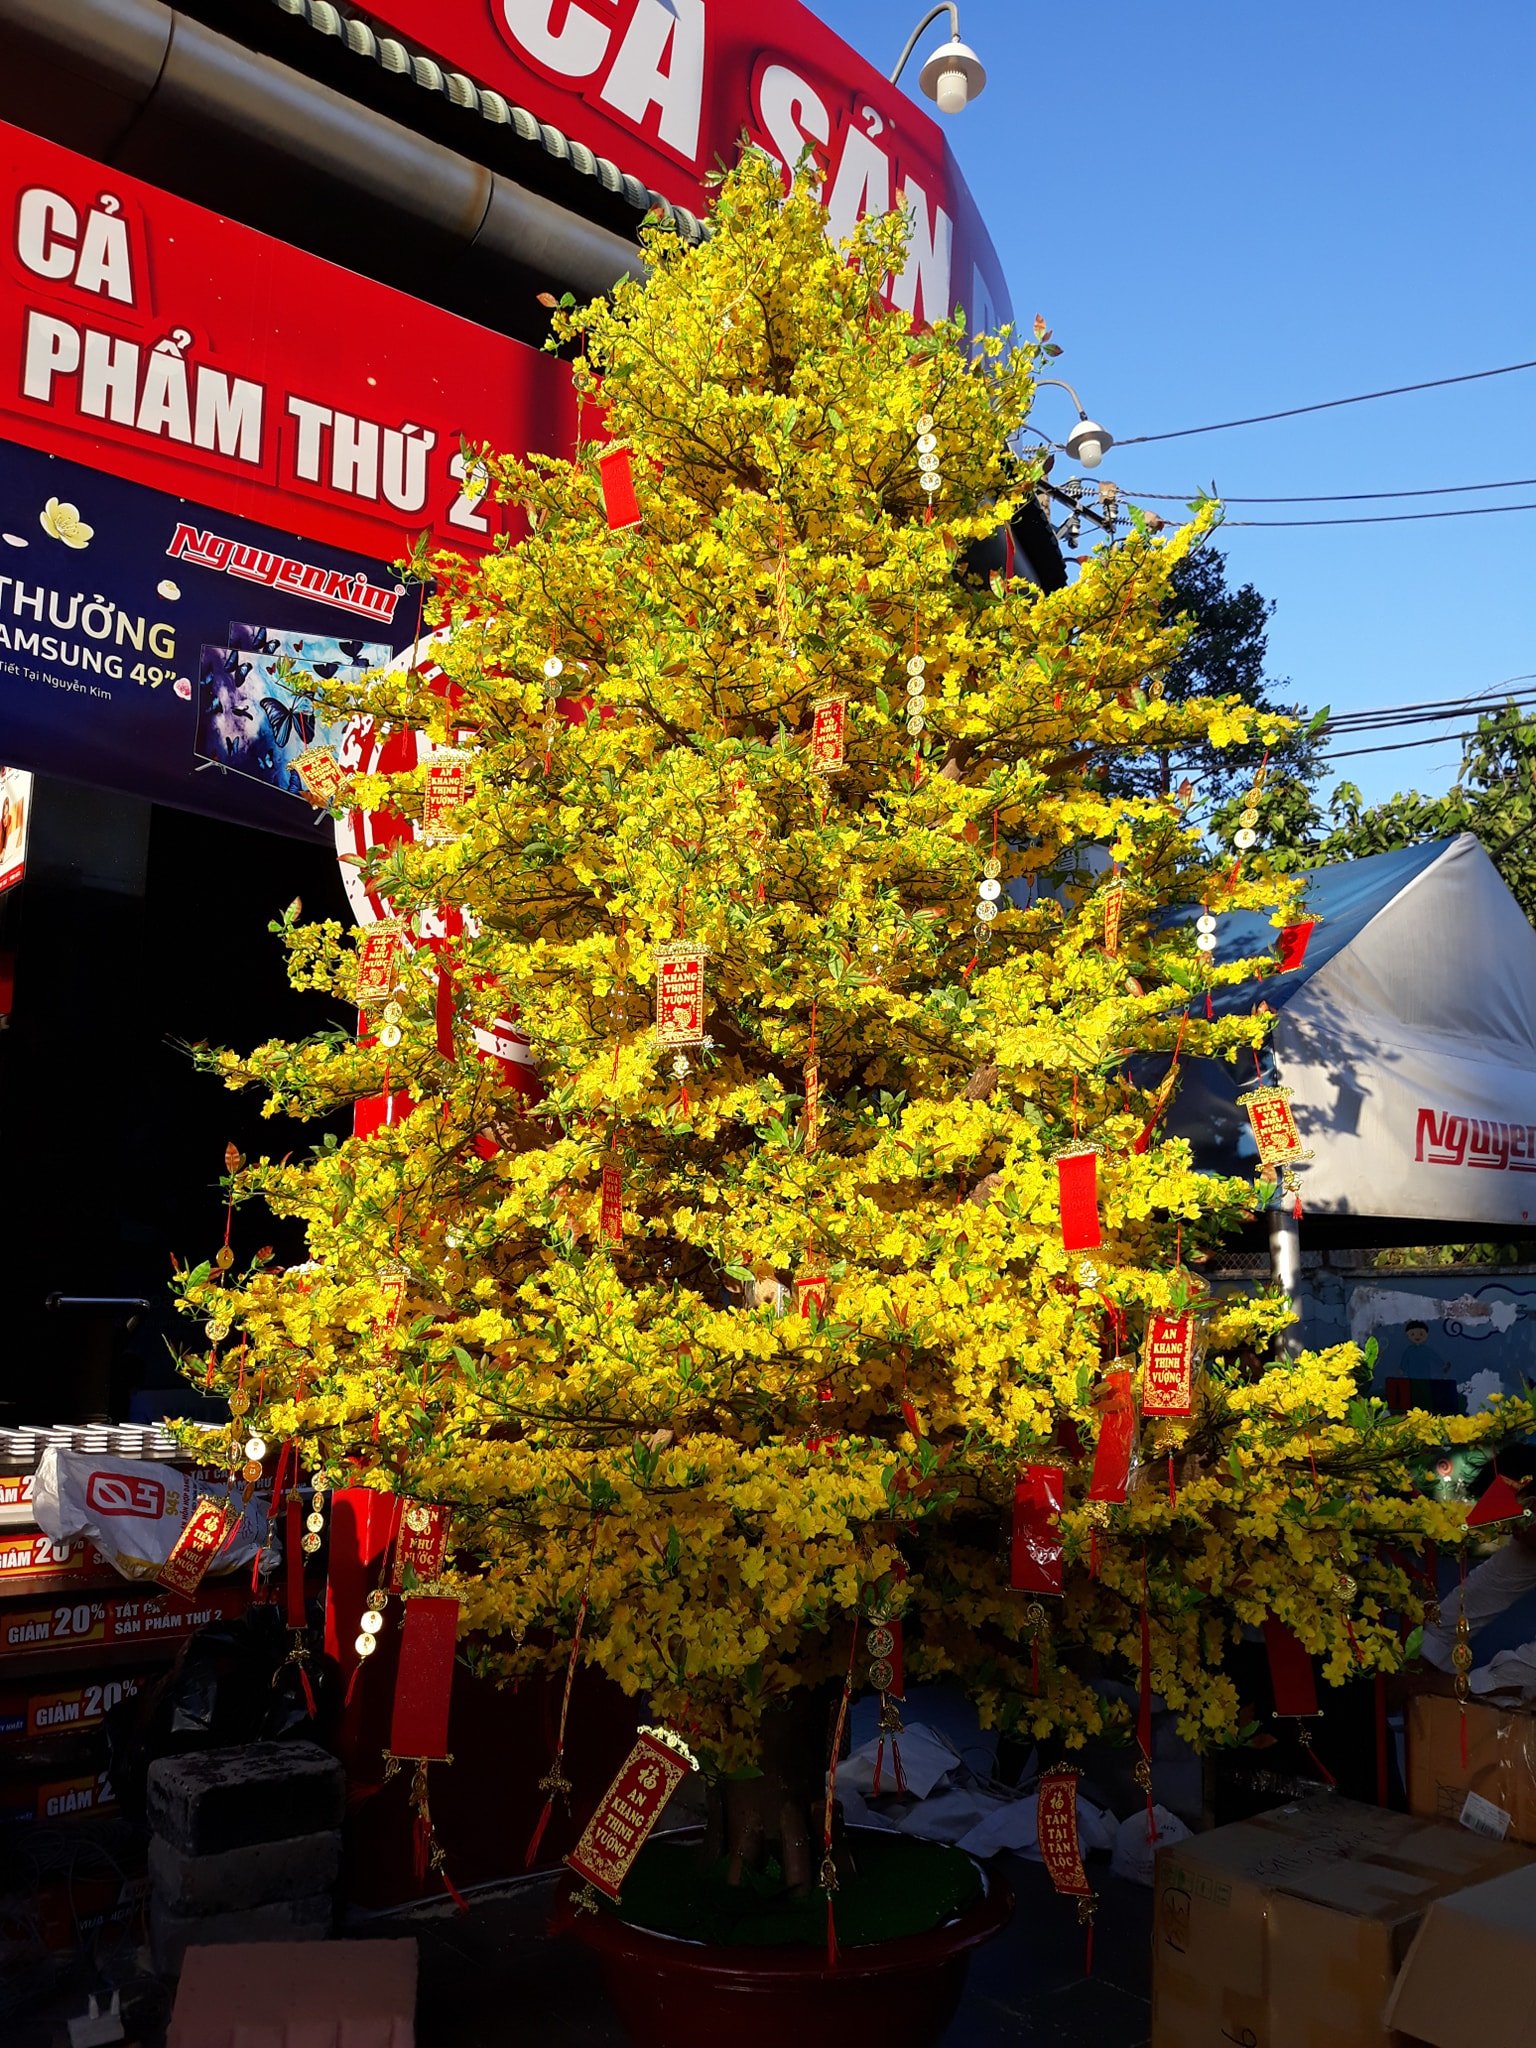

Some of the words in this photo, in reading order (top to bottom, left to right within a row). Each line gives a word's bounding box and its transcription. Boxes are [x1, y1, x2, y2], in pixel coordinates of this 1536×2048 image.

[17, 189, 134, 305] CẢ
[23, 310, 265, 466] PHẨM
[287, 396, 436, 513] THỨ
[448, 453, 489, 533] 2
[0, 623, 124, 680] AMSUNG
[22, 667, 40, 683] Tại
[42, 673, 87, 695] Nguyễn
[89, 686, 112, 701] Kim
[440, 768, 453, 777] AN
[431, 777, 460, 785] KHANG
[673, 963, 688, 973] AN
[663, 972, 697, 984] KHANG
[665, 983, 695, 994] THỊNH
[1261, 1114, 1284, 1126] NHƯ
[1161, 1328, 1177, 1340] AN
[1153, 1343, 1183, 1354] KHANG
[1154, 1357, 1180, 1370] THỊNH
[1152, 1369, 1181, 1385] VƯỢNG
[214, 1609, 223, 1622] 2
[8, 1620, 50, 1645] GIẢM
[54, 1602, 106, 1636] 20%
[36, 1700, 80, 1727] GIẢM
[83, 1679, 138, 1718] 20%
[46, 1788, 93, 1817] GIẢM
[627, 1788, 648, 1807] AN
[610, 1796, 645, 1828] KHANG
